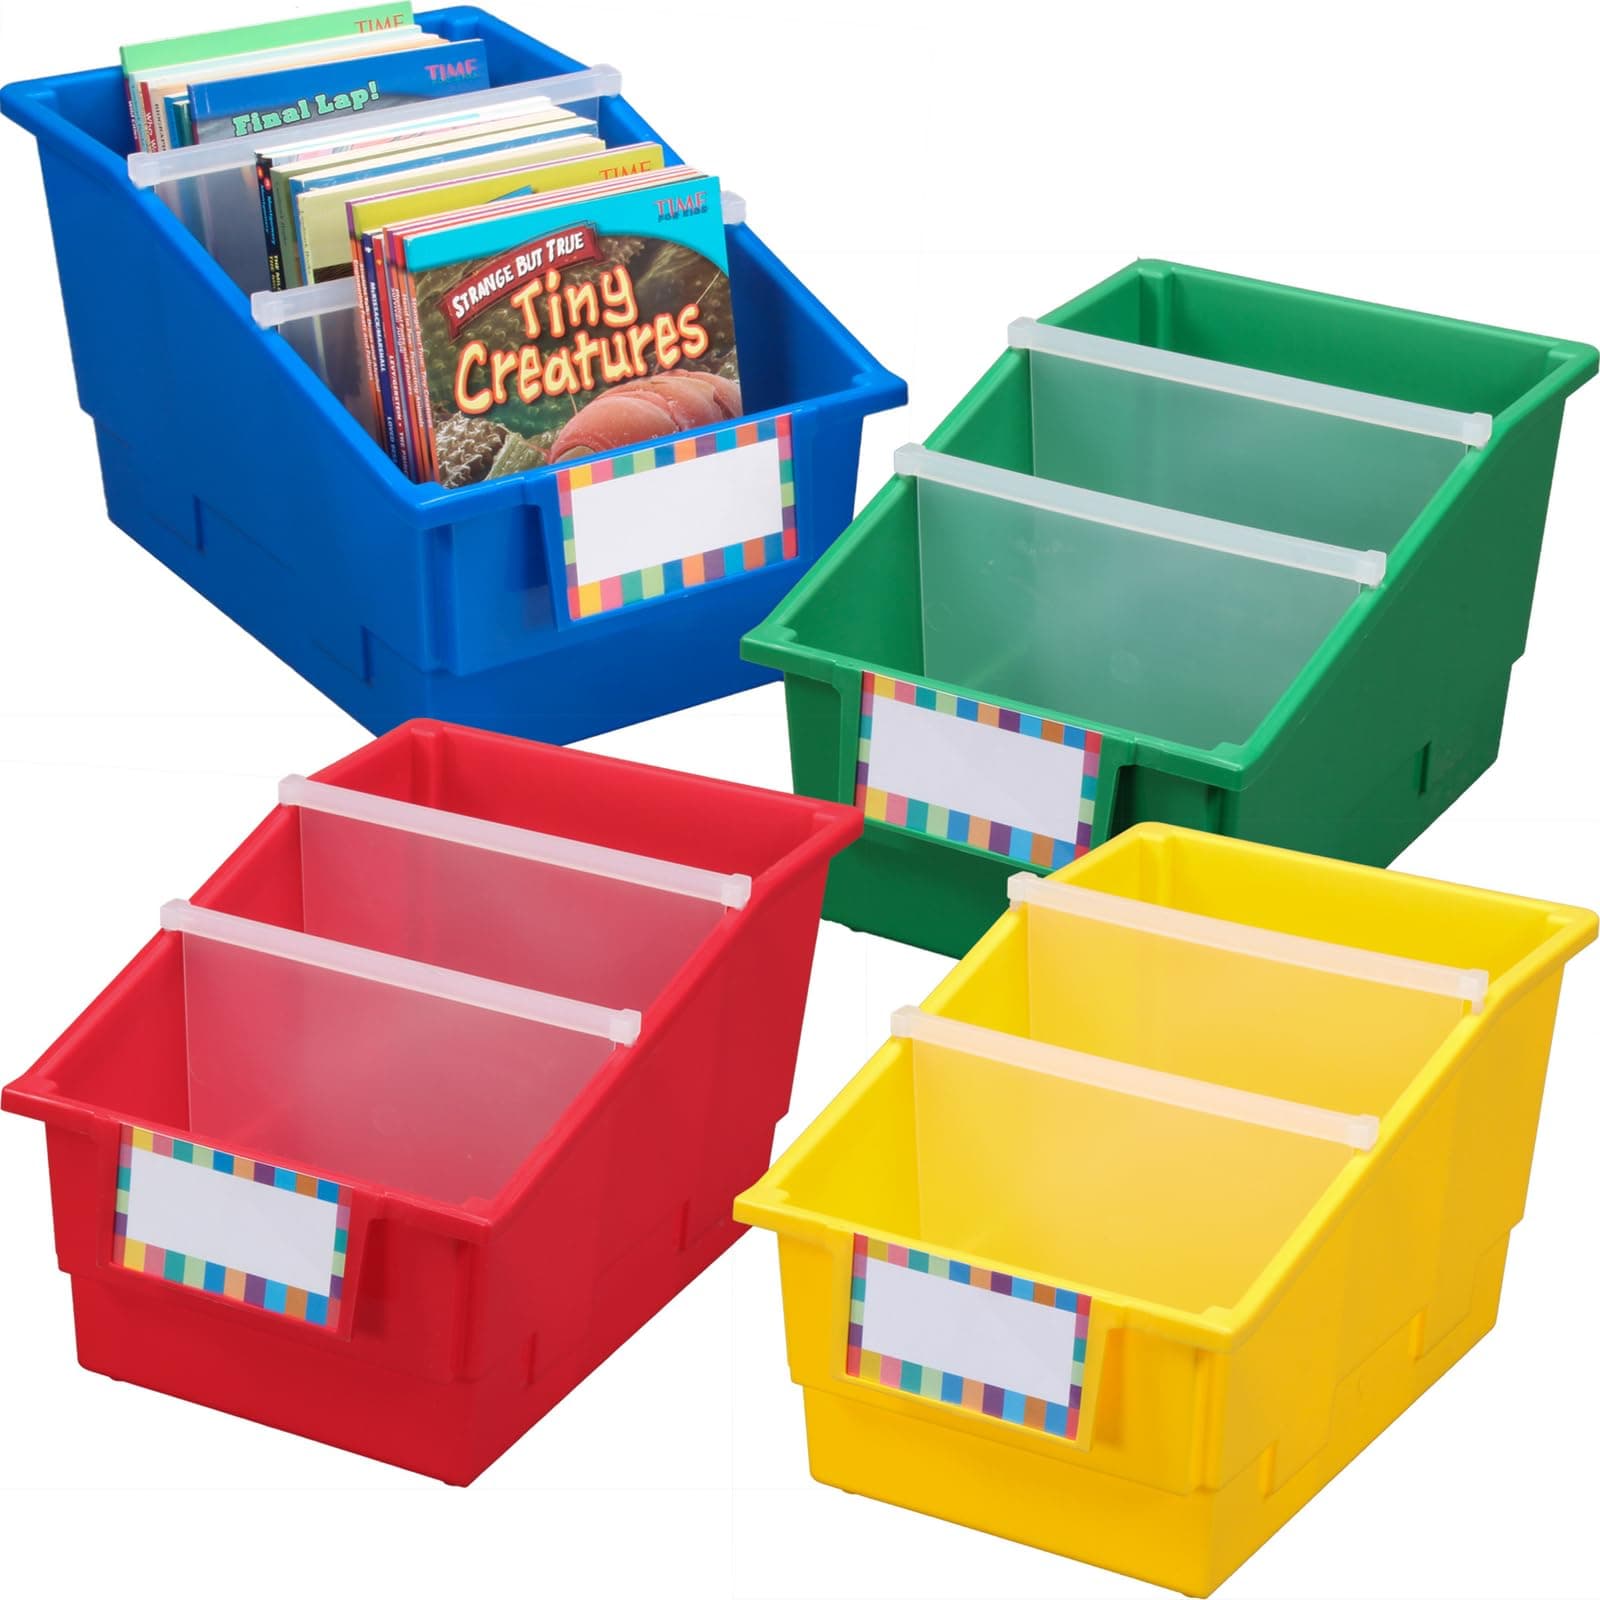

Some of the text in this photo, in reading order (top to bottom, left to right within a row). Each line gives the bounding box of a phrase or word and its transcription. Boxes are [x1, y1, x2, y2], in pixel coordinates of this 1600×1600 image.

[425, 58, 478, 82] TIME
[232, 80, 380, 137] Final Lap!
[653, 192, 707, 219] TIME
[451, 231, 585, 319] STRANGE BUT TRUE
[510, 264, 639, 339] Tiny
[454, 303, 709, 415] Creatures
